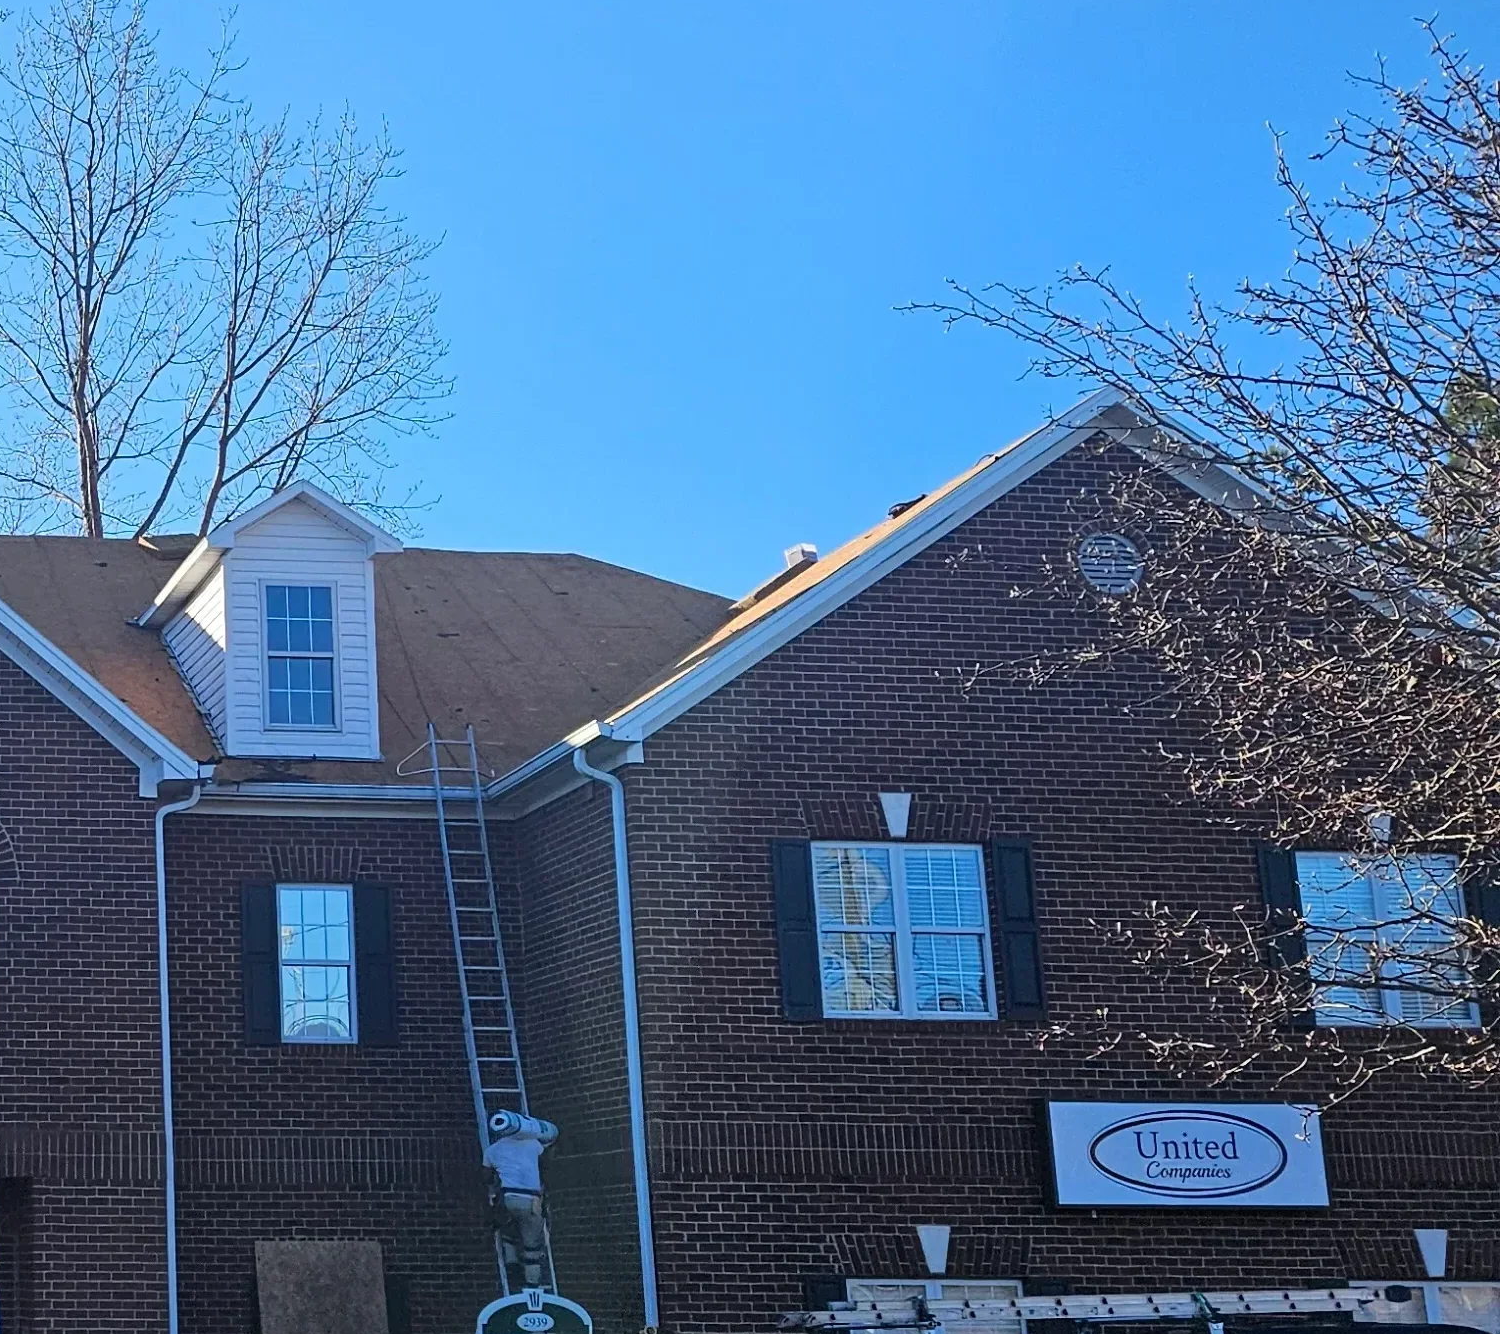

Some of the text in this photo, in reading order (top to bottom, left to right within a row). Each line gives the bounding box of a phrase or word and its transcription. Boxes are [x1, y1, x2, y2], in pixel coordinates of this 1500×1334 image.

[1133, 1131, 1239, 1160] United
[1146, 1161, 1231, 1183] Companies
[523, 1317, 548, 1327] 2939
